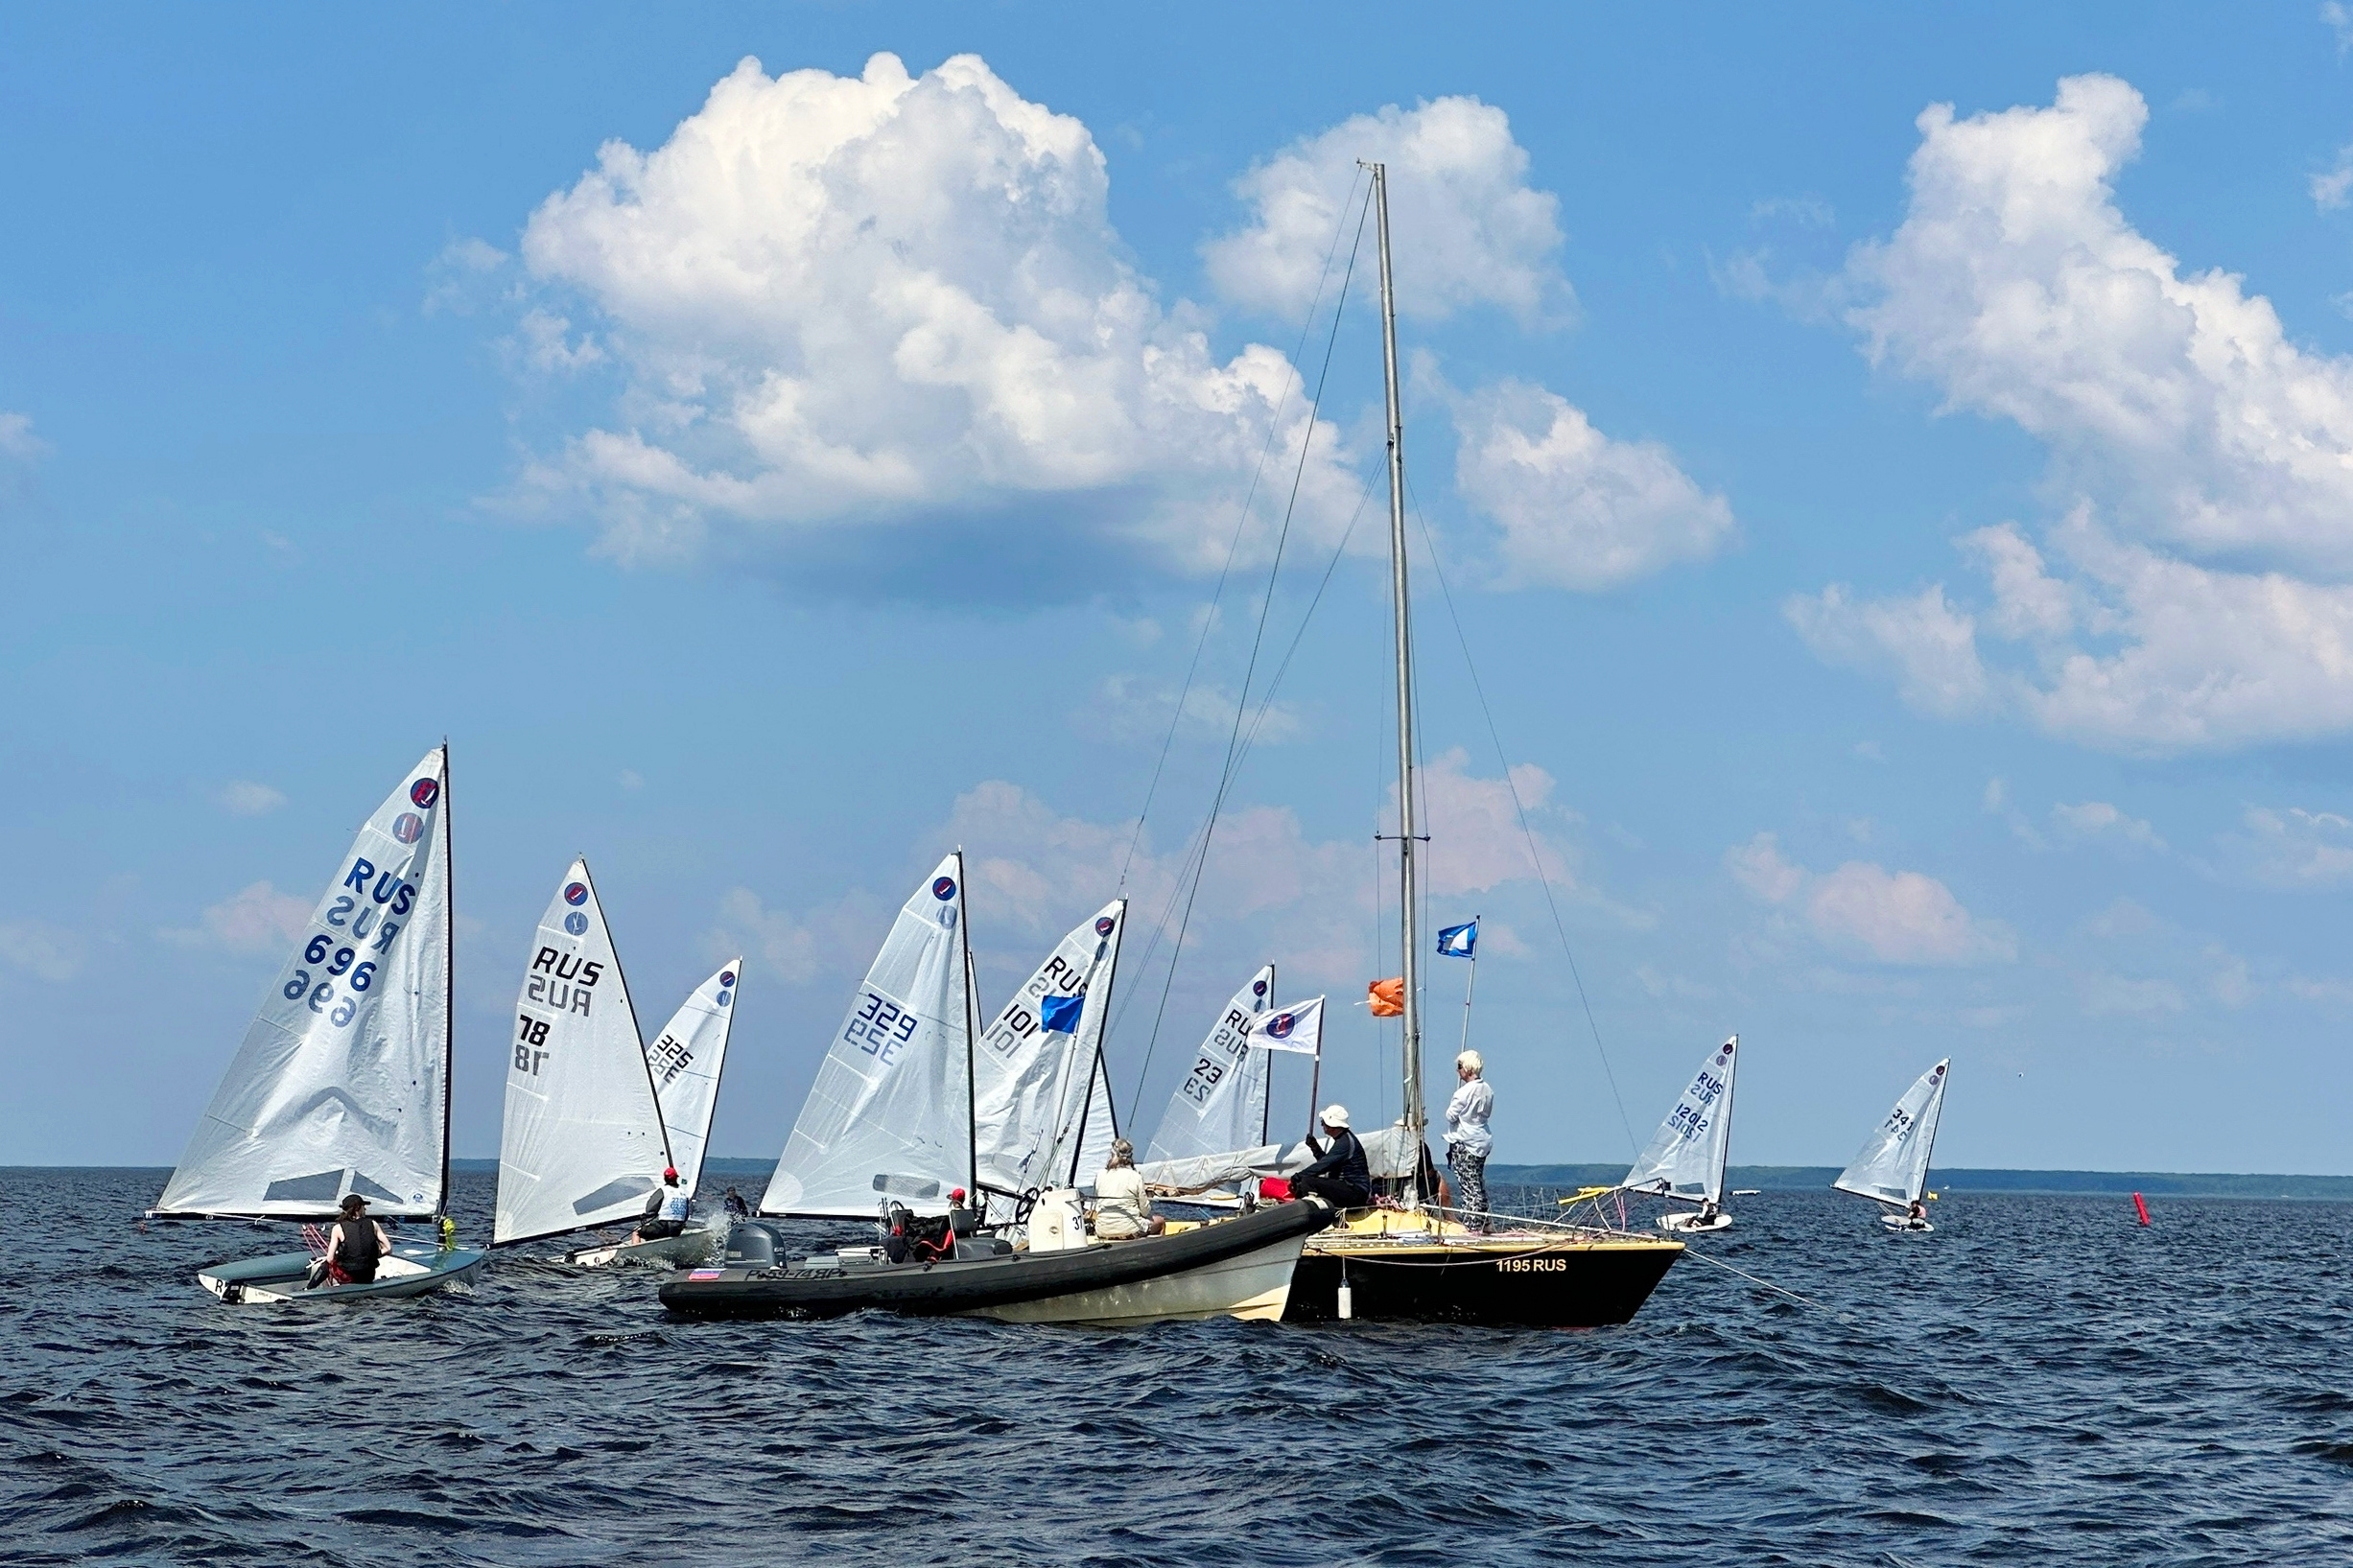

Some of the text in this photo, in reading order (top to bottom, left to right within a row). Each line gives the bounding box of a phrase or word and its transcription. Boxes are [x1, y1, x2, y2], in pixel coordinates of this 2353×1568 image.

[343, 857, 415, 915] RUS
[304, 934, 377, 992] 696
[532, 946, 604, 987] RUS
[519, 1014, 551, 1047] 78
[858, 993, 918, 1042] 329
[1003, 1004, 1039, 1040] 101
[1225, 1009, 1253, 1039] RU
[657, 1035, 694, 1069] 325
[1193, 1058, 1223, 1085] 23
[1697, 1071, 1723, 1094] RUS
[1675, 1103, 1708, 1132] 12012
[1893, 1109, 1914, 1131] 341
[1496, 1258, 1566, 1272] 1195 RUS
